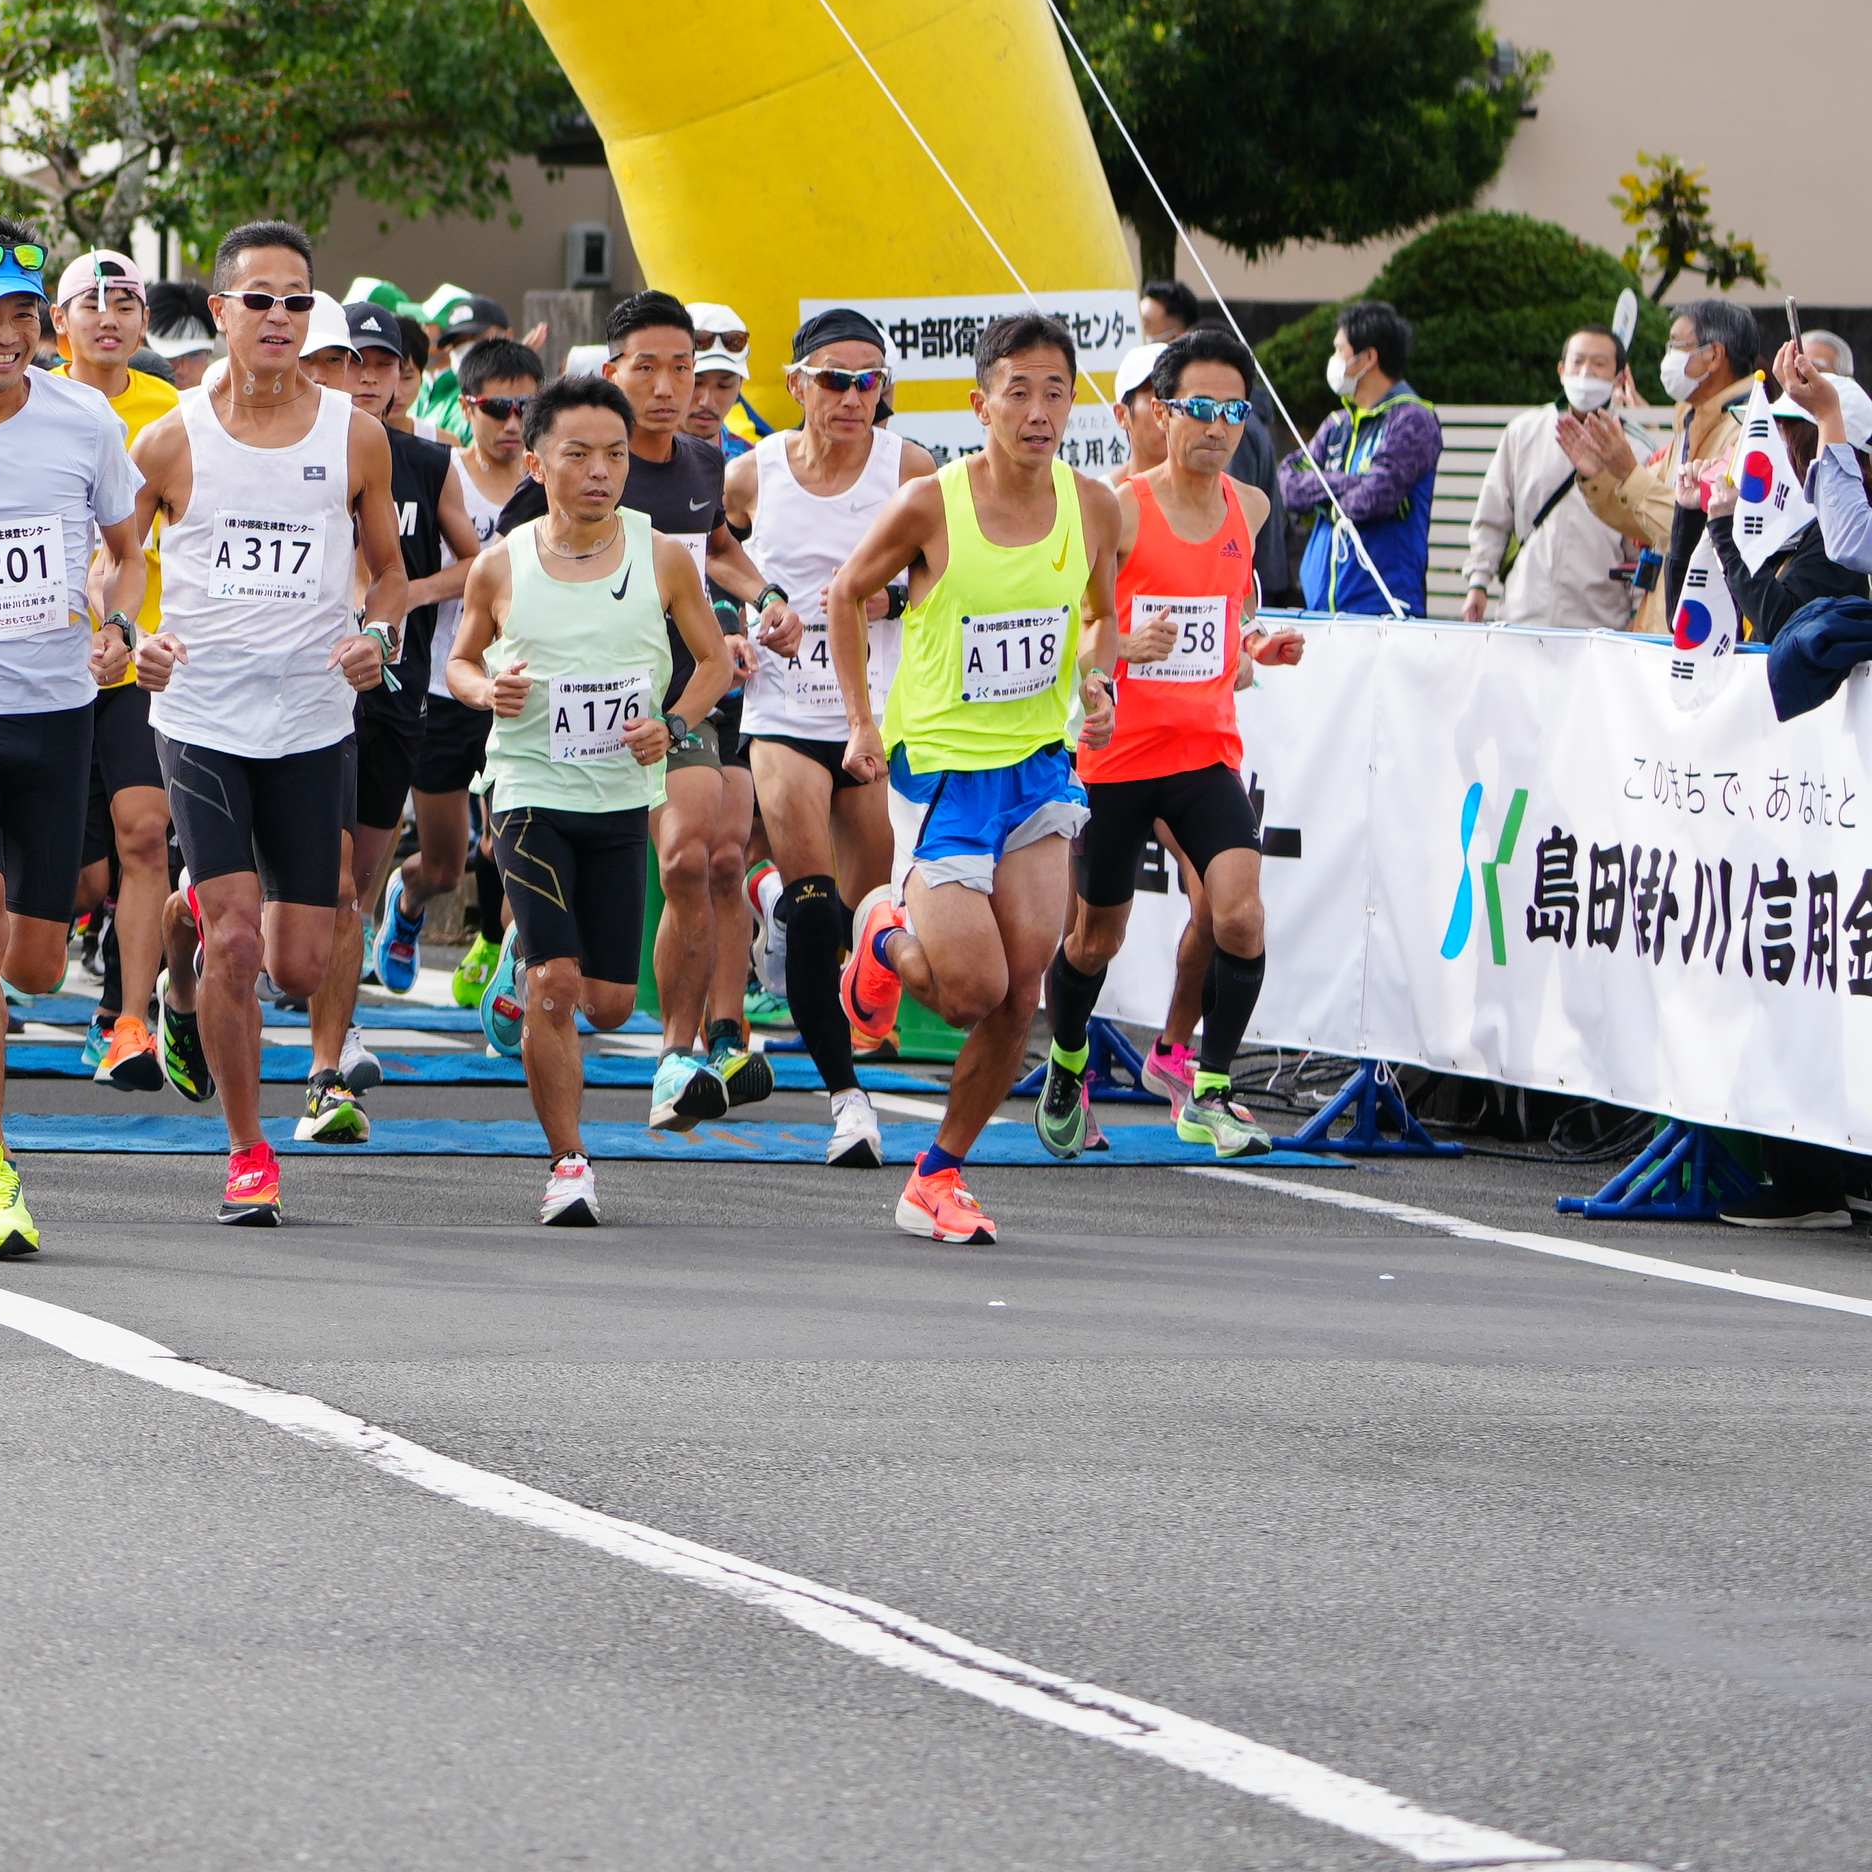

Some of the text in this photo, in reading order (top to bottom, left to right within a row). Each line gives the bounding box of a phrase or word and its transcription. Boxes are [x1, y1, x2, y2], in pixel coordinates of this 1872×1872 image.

[215, 537, 311, 574] A 317
[967, 633, 1056, 673] A 118
[554, 692, 640, 734] A 176
[1624, 757, 1856, 829] このまちで、あなたと
